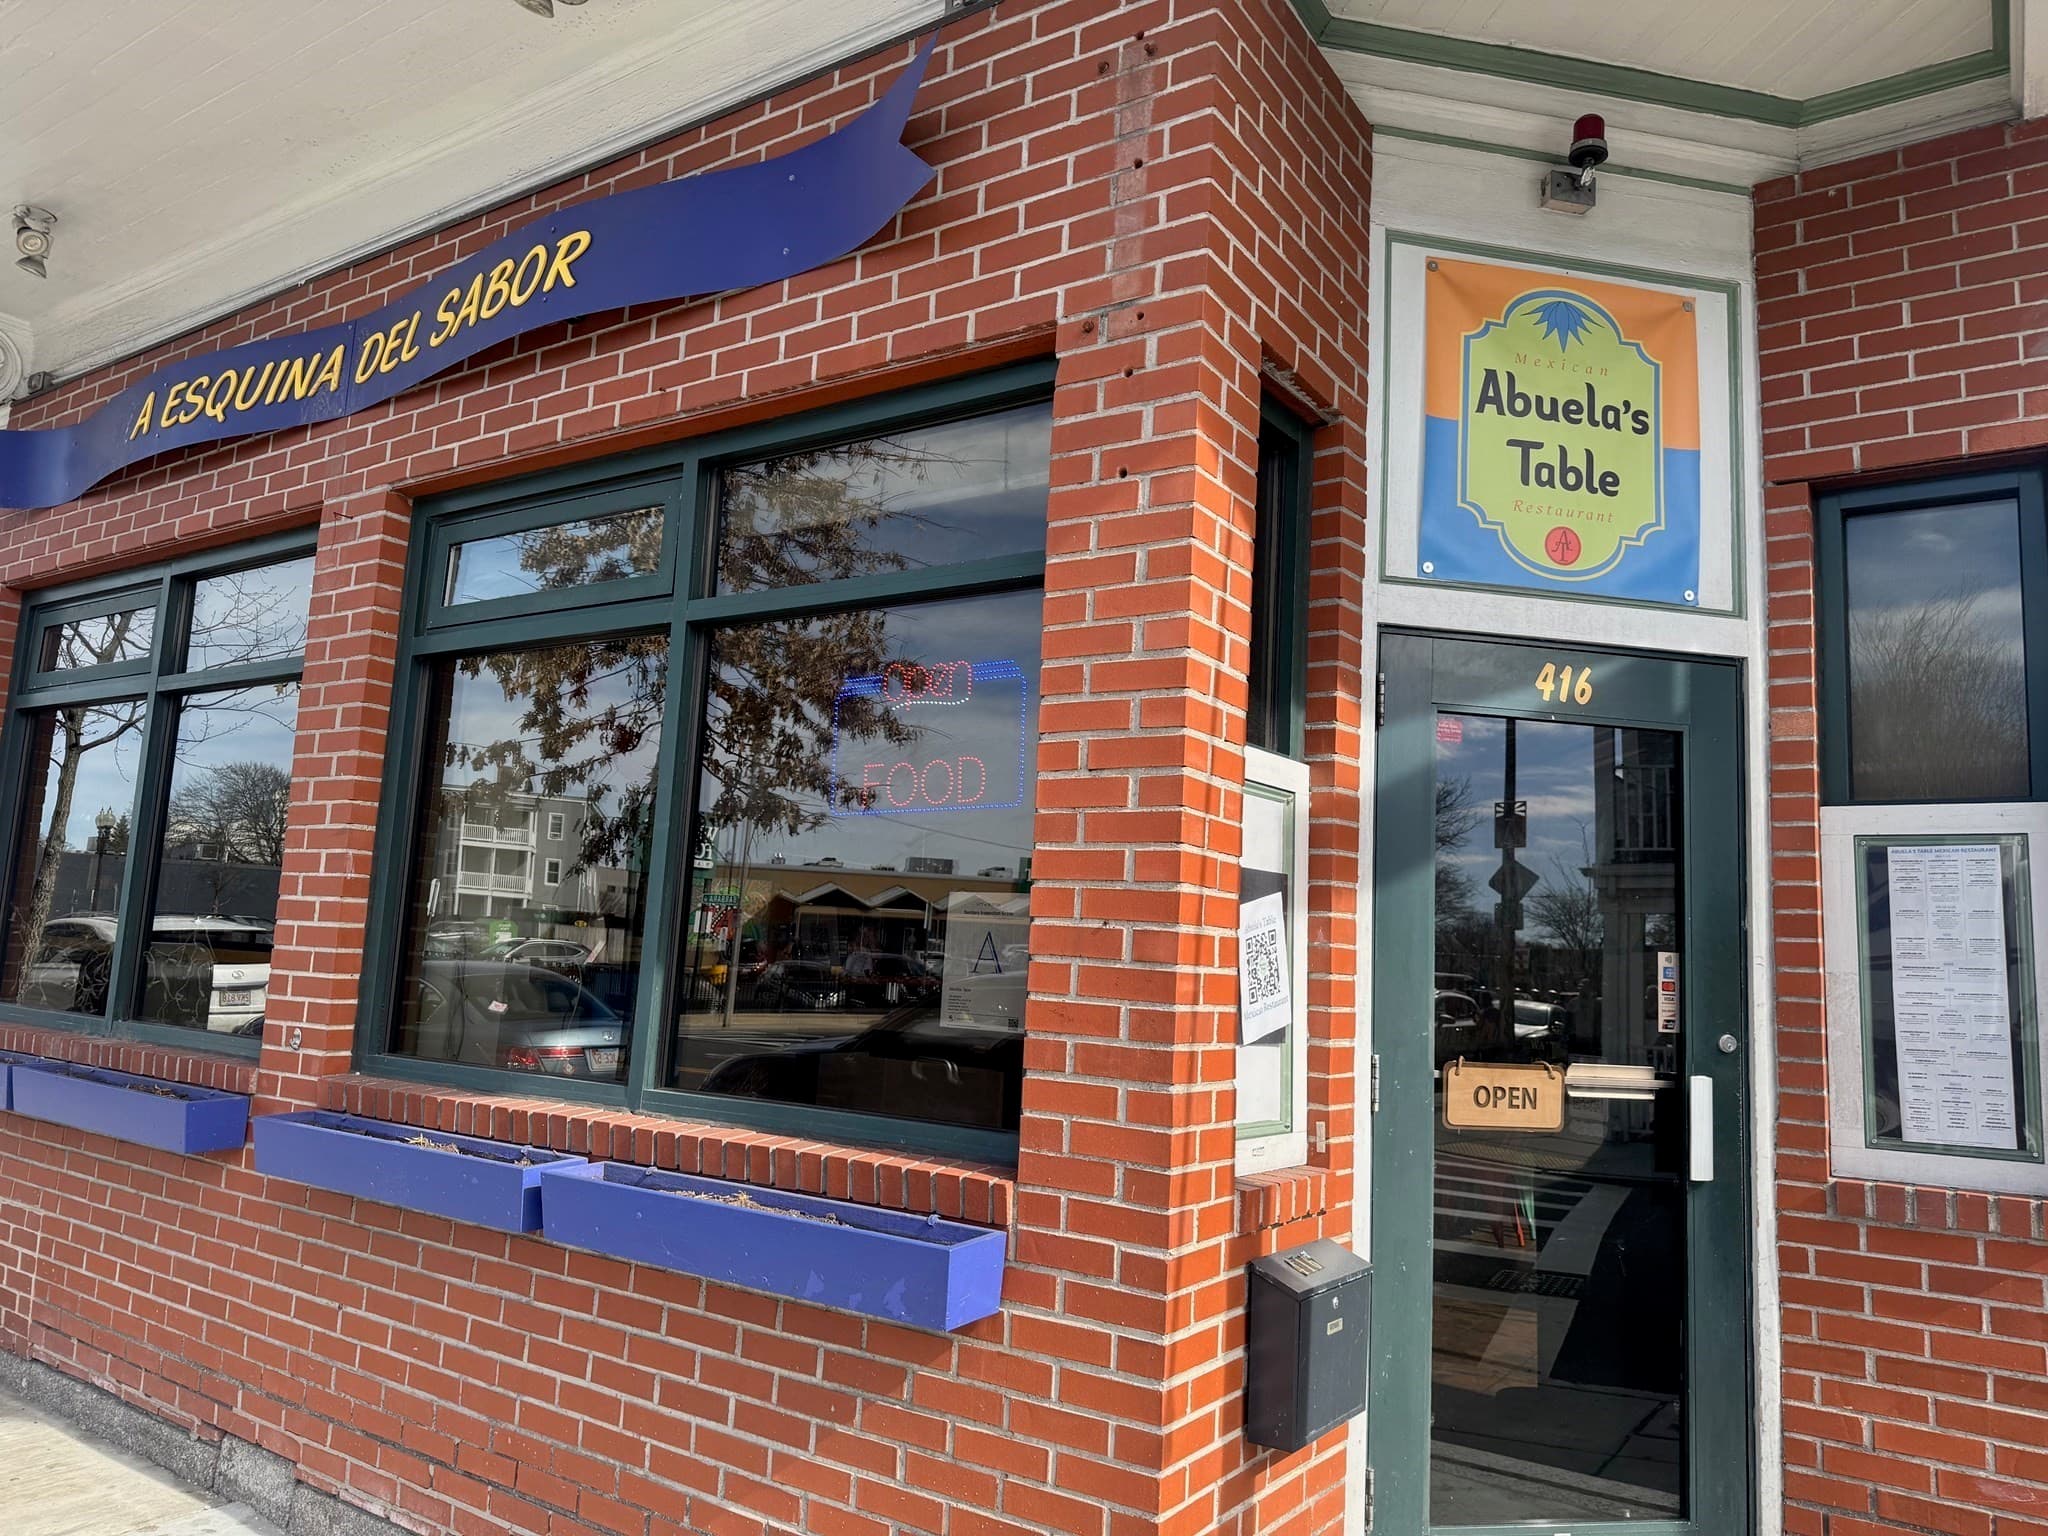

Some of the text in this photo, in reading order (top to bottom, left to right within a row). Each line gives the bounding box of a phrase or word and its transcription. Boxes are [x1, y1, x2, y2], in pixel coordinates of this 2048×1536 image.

[129, 230, 592, 440] A ESQUINA DEL SABOR
[1514, 352, 1609, 376] Mexican
[1475, 368, 1650, 435] Abuela's
[1506, 439, 1621, 497] Table
[1513, 499, 1614, 523] Restaurant
[1535, 662, 1592, 704] 416
[862, 756, 986, 807] FOOD
[968, 931, 1003, 974] A
[1473, 1085, 1538, 1110] OPEN
